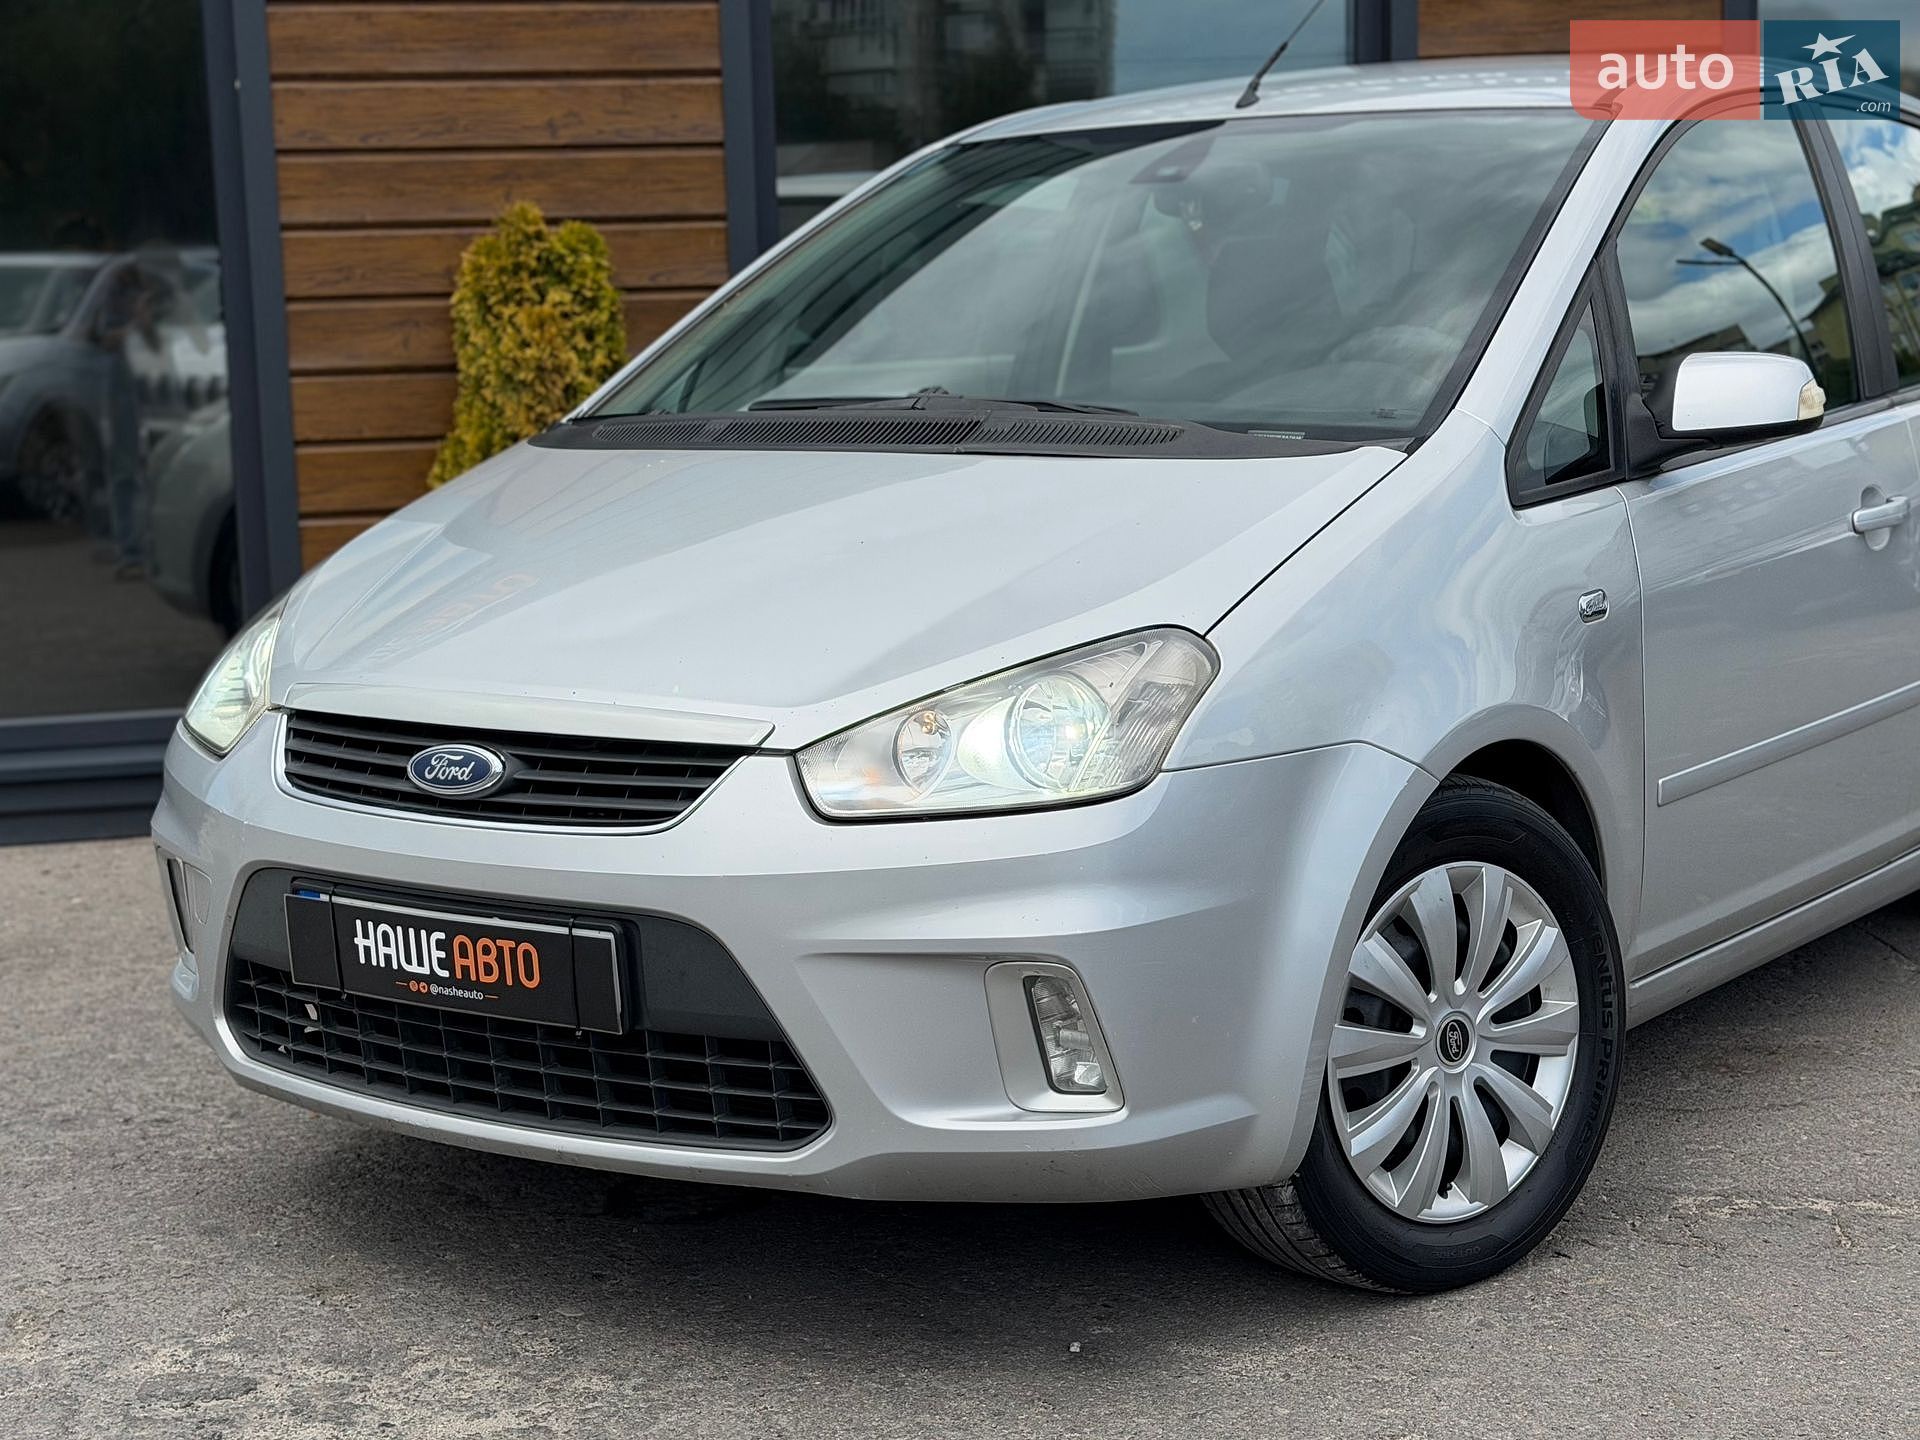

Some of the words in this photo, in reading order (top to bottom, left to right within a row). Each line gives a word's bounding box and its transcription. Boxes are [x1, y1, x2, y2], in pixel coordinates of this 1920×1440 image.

[424, 753, 475, 781] Ford
[354, 918, 450, 978] НАШЕ
[452, 934, 541, 989] АВТО
[430, 983, 485, 1001] @nasheauto
[1448, 1030, 1462, 1055] Ford
